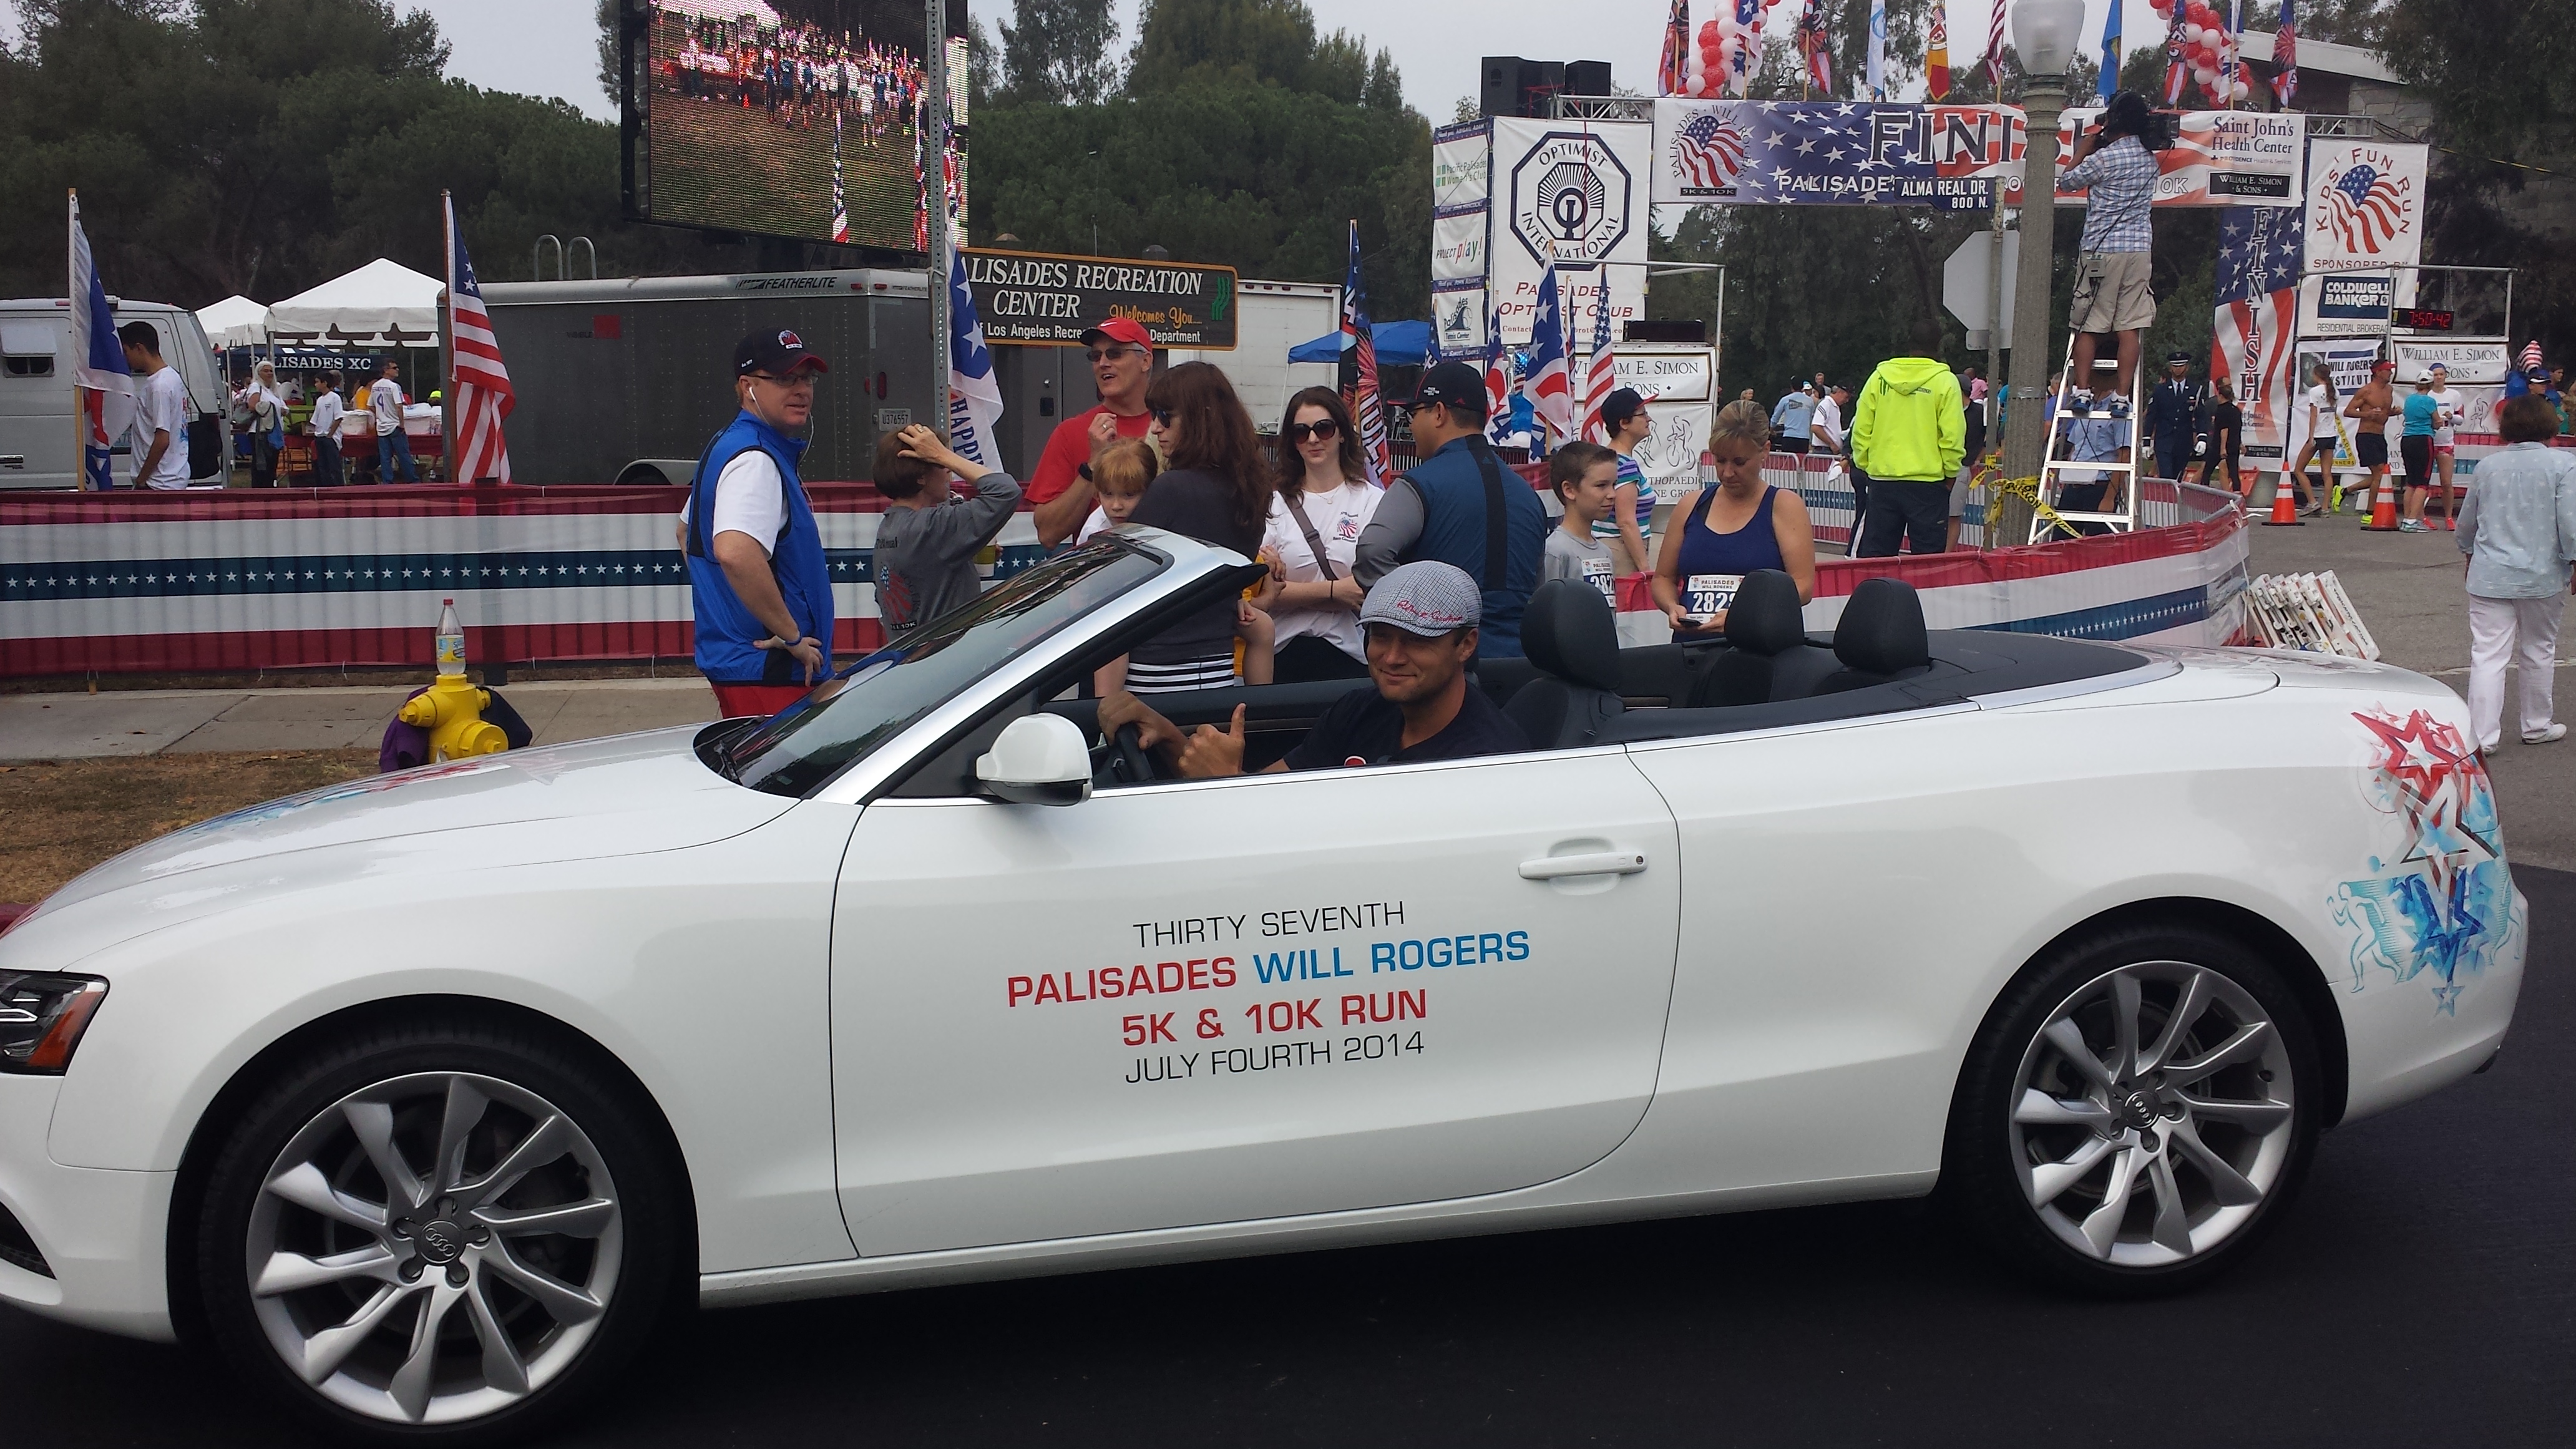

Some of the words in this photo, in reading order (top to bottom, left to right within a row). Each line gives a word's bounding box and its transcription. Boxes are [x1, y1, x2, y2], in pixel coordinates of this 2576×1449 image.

[2213, 116, 2250, 134] Saint
[2251, 118, 2294, 139] John's
[1669, 109, 1699, 178] PALISADES
[1712, 105, 1739, 125] WILL
[1737, 125, 1752, 180] ROGERS
[2212, 137, 2250, 151] Health
[2254, 139, 2292, 154] Center
[1539, 143, 1608, 167] OPTIMIST
[1447, 162, 1463, 173] Pacific
[1463, 159, 1487, 172] Palisades
[1473, 170, 1486, 181] Club
[2219, 175, 2247, 183] WILLIAM
[2258, 177, 2283, 185] SIMON
[1901, 180, 1933, 197] ALMA
[1938, 180, 1968, 197] REAL
[1970, 180, 1989, 195] DR.
[2235, 185, 2242, 193] &
[2243, 185, 2261, 193] SONS
[2351, 147, 2393, 170] FUN
[2397, 176, 2412, 234] RUN
[1951, 197, 1973, 209] 800
[1978, 197, 1989, 209] N.
[1437, 248, 1456, 259] PROJECT
[1455, 236, 1483, 265] play!
[765, 277, 837, 289] FEATHERLITE
[1075, 265, 1203, 295] RECREATION
[993, 289, 1081, 318] CENTER
[2239, 207, 2273, 403] FINISH
[2325, 294, 2378, 308] BANKER
[1110, 304, 1166, 324] Welcomes
[1444, 297, 1468, 329] Palisades
[1586, 304, 1633, 317] CUB
[987, 322, 1007, 336] Los
[1010, 323, 1050, 339] Angeles
[1149, 329, 1201, 344] Department
[2317, 323, 2356, 333] RESIDENTIAL
[2402, 348, 2448, 360] WILLIAM
[2453, 348, 2462, 360] E.
[2467, 348, 2500, 361] SIMON
[348, 358, 371, 369] XC
[1636, 361, 1648, 374] E.
[1654, 361, 1699, 374] SIMON
[2446, 366, 2470, 378] SONS
[882, 414, 909, 424] U376557
[1133, 914, 1246, 948] THIRTY
[1261, 901, 1405, 937] SEVENTH
[1007, 956, 1236, 1007] PALISADES
[1253, 947, 1353, 984] WILL
[1372, 930, 1530, 973] ROGERS
[1123, 1012, 1178, 1046] 5K
[1196, 1008, 1224, 1038] &
[1245, 998, 1323, 1034] 10K
[1341, 989, 1427, 1027] RUN
[1125, 1053, 1200, 1083] JULY
[1211, 1040, 1332, 1076] FOURTH
[1344, 1031, 1425, 1062] 2014
